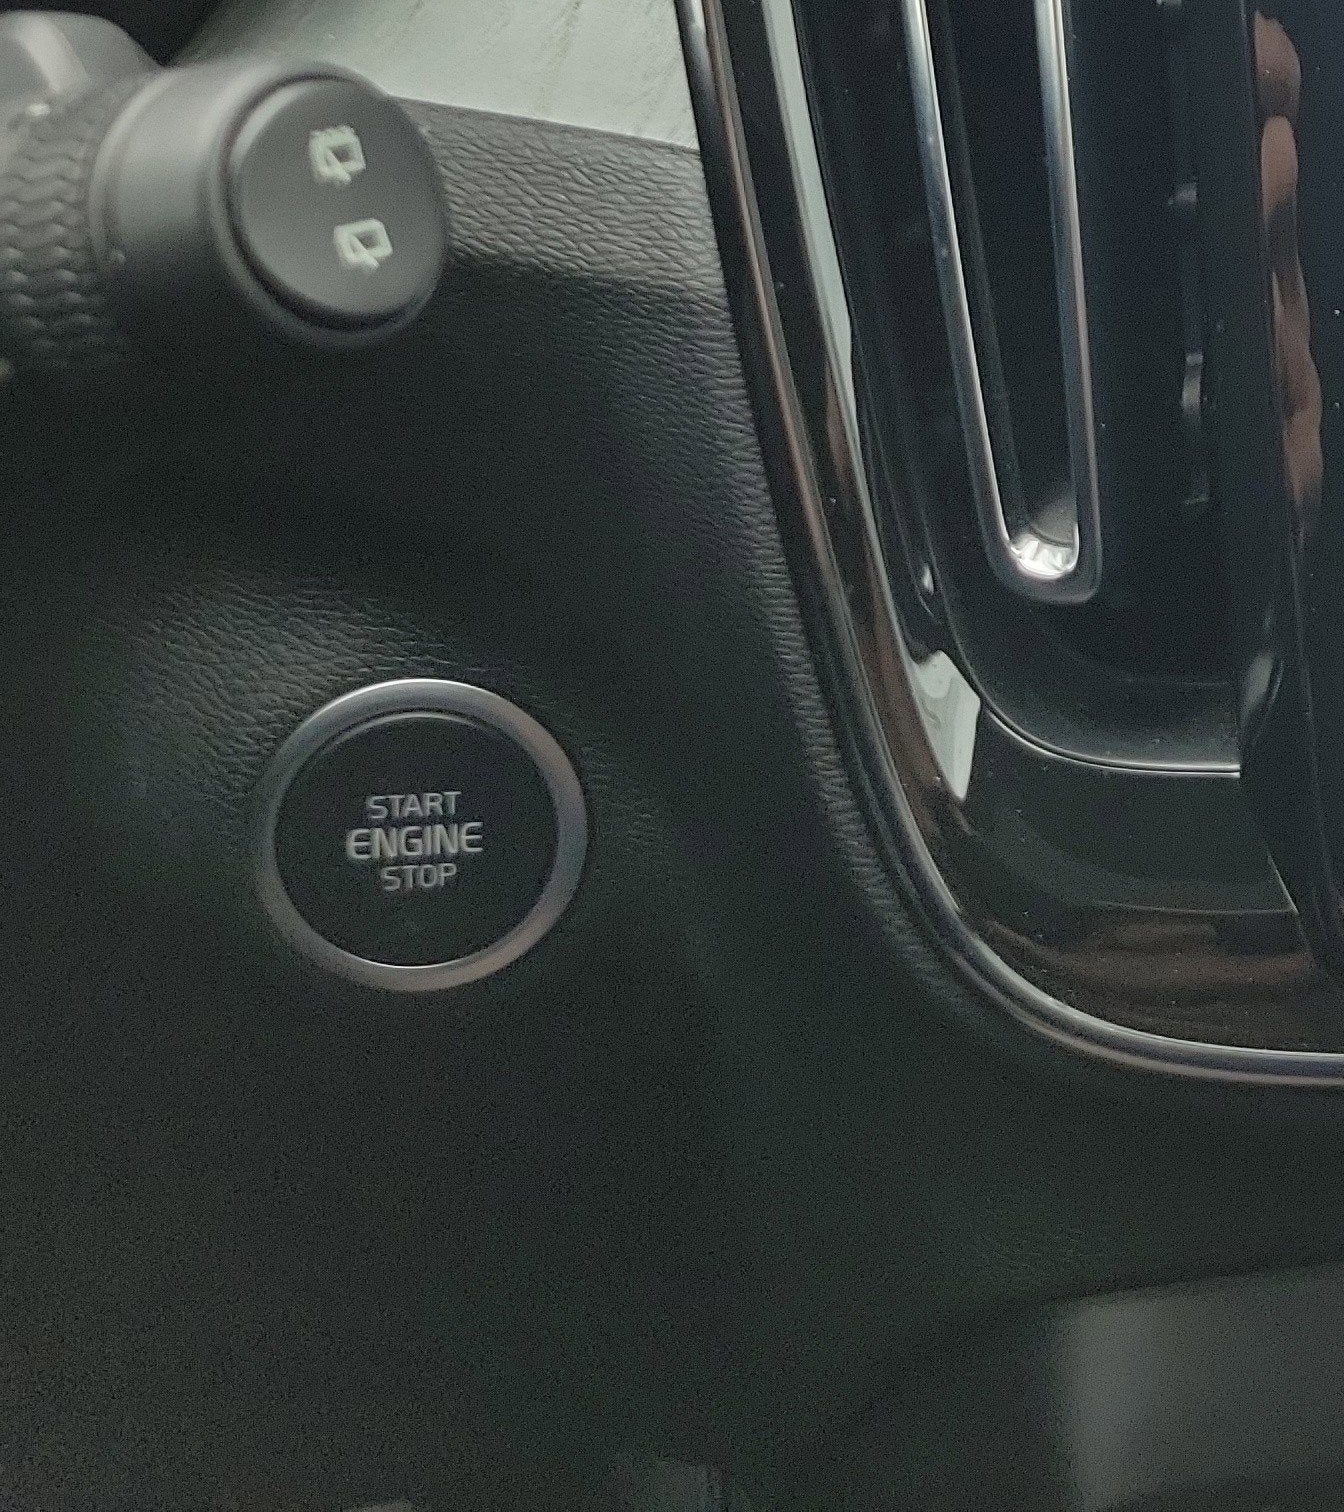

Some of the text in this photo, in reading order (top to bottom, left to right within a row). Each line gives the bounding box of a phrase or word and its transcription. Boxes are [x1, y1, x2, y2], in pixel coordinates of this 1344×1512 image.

[365, 791, 462, 820] START
[345, 821, 484, 861] ENGINE
[380, 862, 458, 892] STOP
